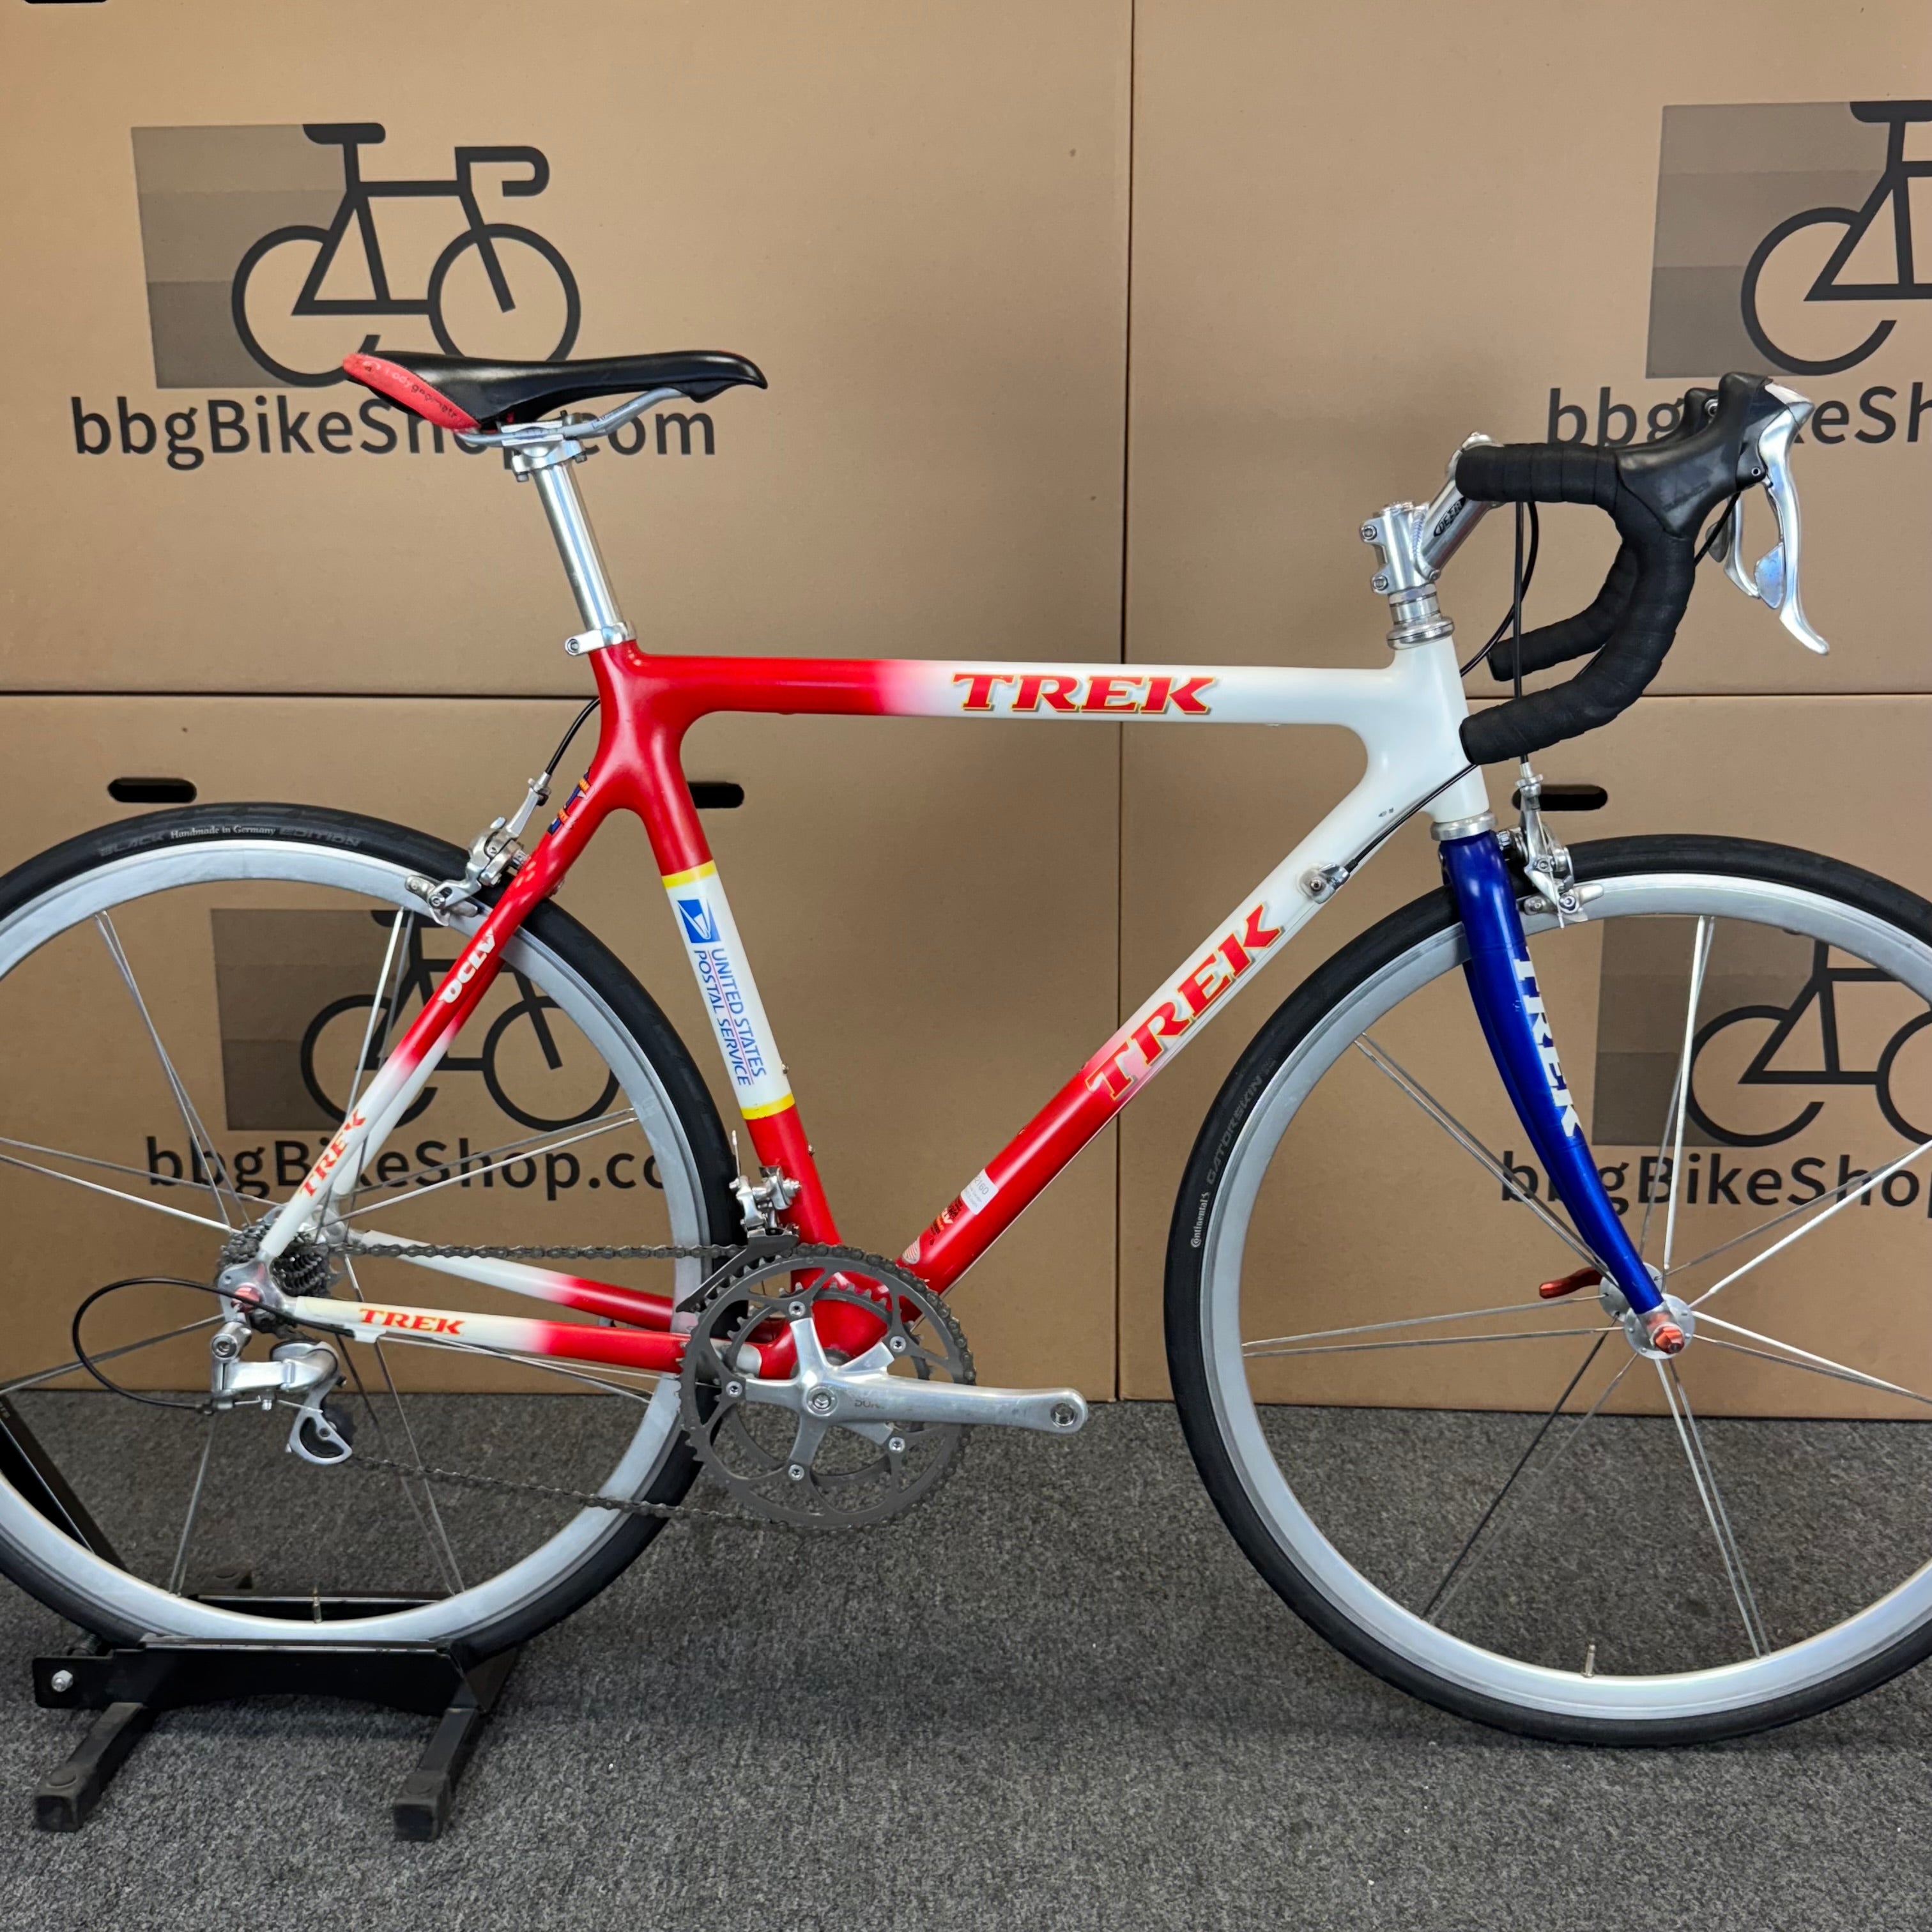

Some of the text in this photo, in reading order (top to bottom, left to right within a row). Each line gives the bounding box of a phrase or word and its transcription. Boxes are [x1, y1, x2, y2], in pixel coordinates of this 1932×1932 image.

[951, 673, 1216, 714] TREK
[170, 825, 220, 839] Handmade
[233, 825, 276, 836] Germany
[694, 949, 751, 1086] POSTAL SERVICE
[710, 948, 767, 1077] UNITED STATES
[1084, 902, 1284, 1101] TREK
[1513, 946, 1583, 1137] TREK
[298, 1109, 366, 1197] TREK
[1206, 1074, 1262, 1185] GATORSKIN
[1190, 1197, 1209, 1248] Continental
[360, 1308, 465, 1335] TREK
